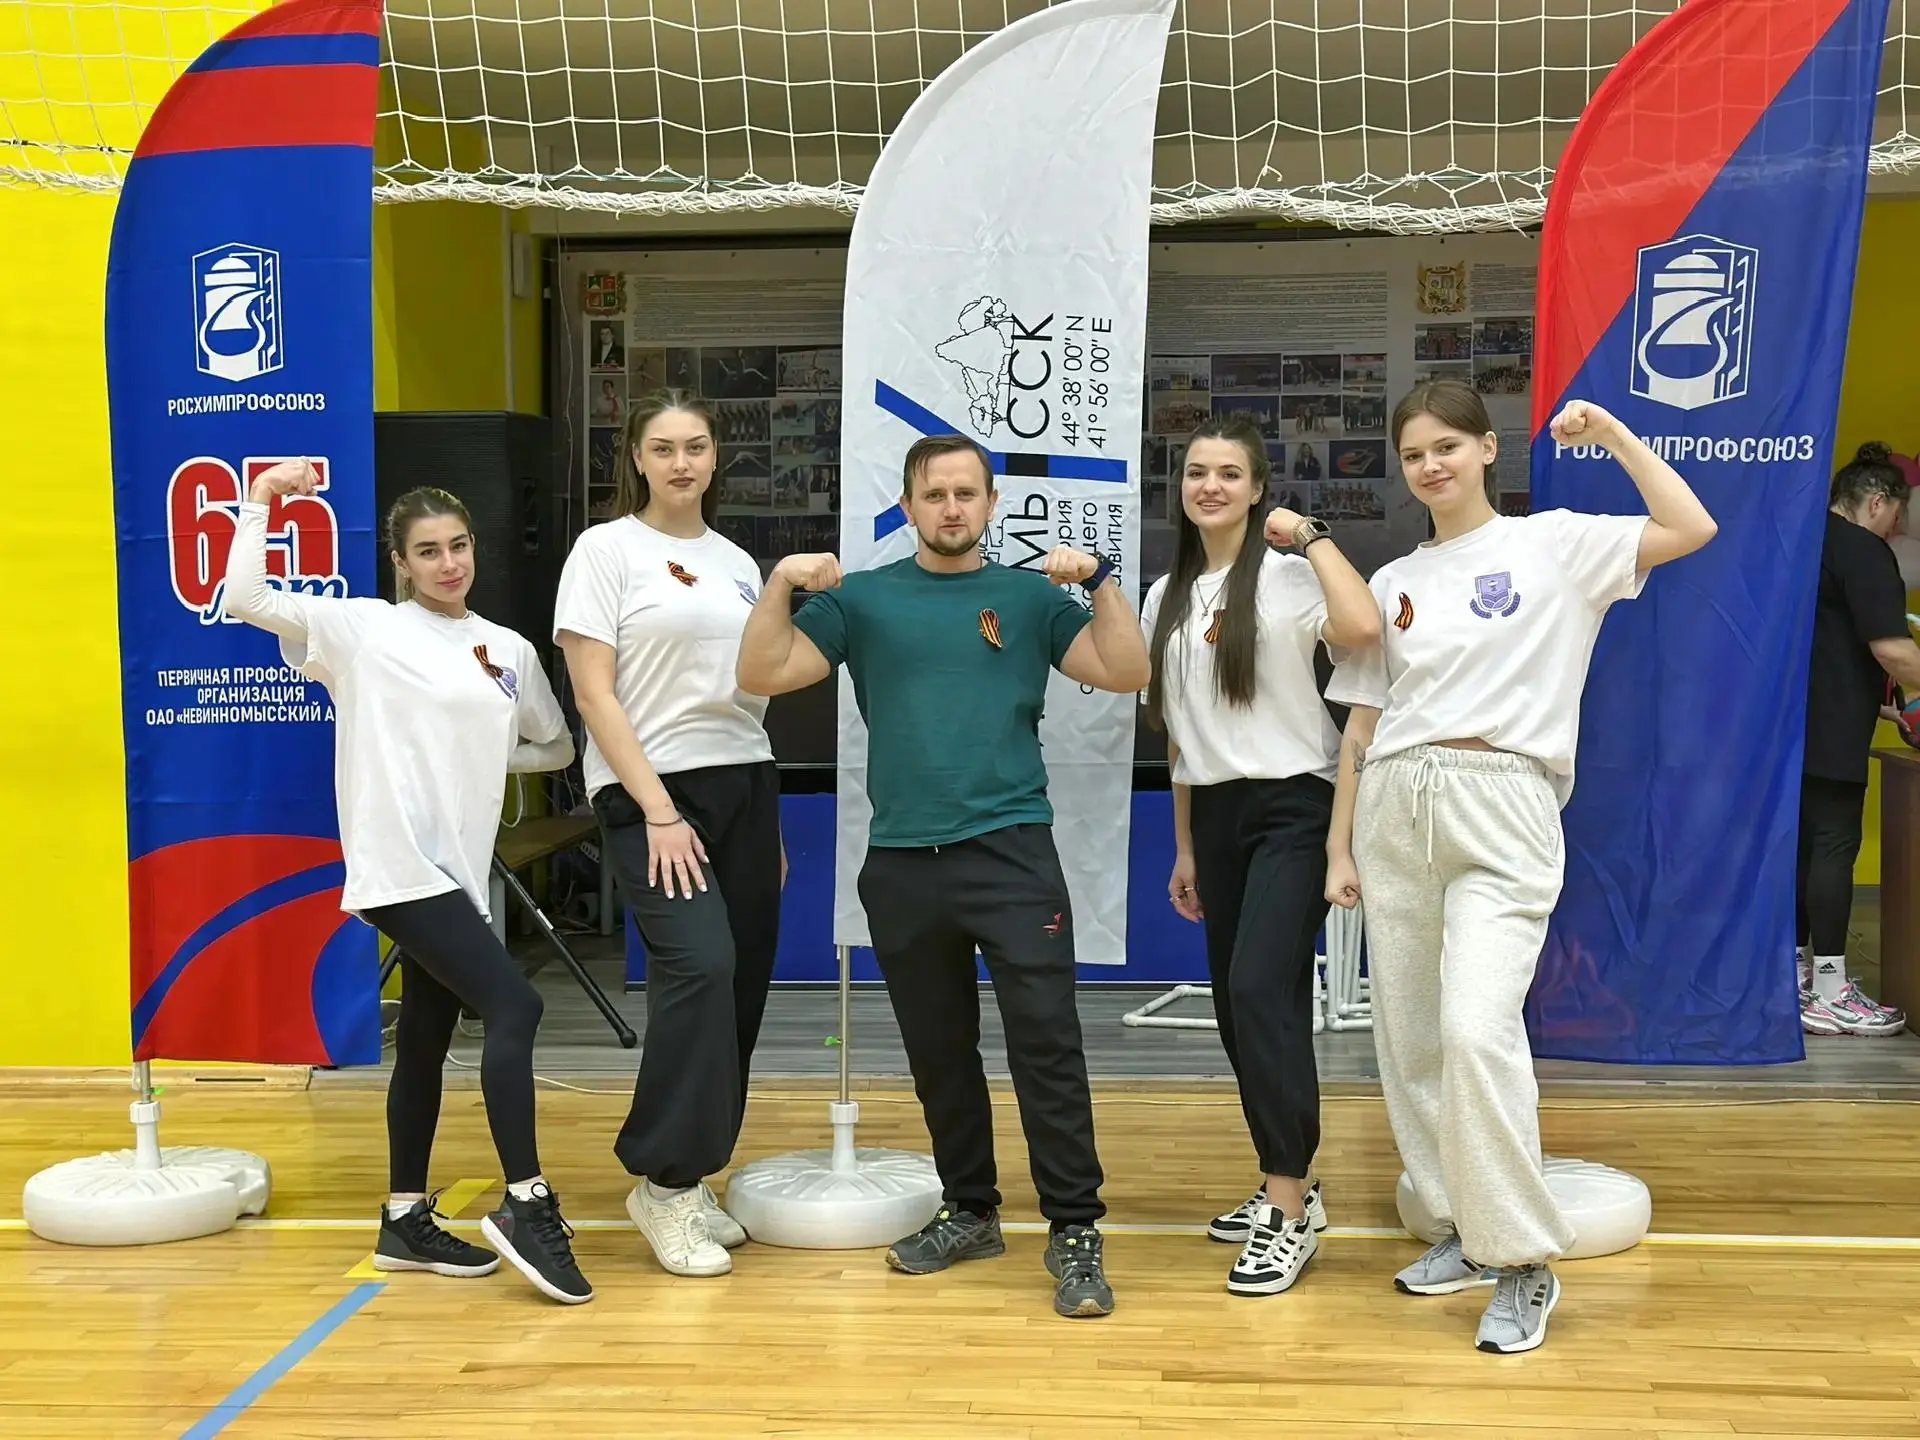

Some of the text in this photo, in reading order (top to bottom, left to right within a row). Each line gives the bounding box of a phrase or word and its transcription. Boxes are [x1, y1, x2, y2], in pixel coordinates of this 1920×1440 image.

[1065, 315, 1085, 331] N
[1091, 317, 1112, 333] E
[1062, 377, 1082, 406] 38'
[1088, 378, 1109, 408] 56'
[168, 393, 326, 416] РОСХИМПРОФСОЮЗ
[167, 456, 339, 612] 65
[158, 666, 314, 687] ПЕРВИЧНАЯ ПРОФСО
[197, 686, 305, 706] ОРГАНИЗАЦИЯ
[146, 709, 174, 725] ОАО
[177, 702, 321, 724] «НЕВИННОМЫССКИЙ
